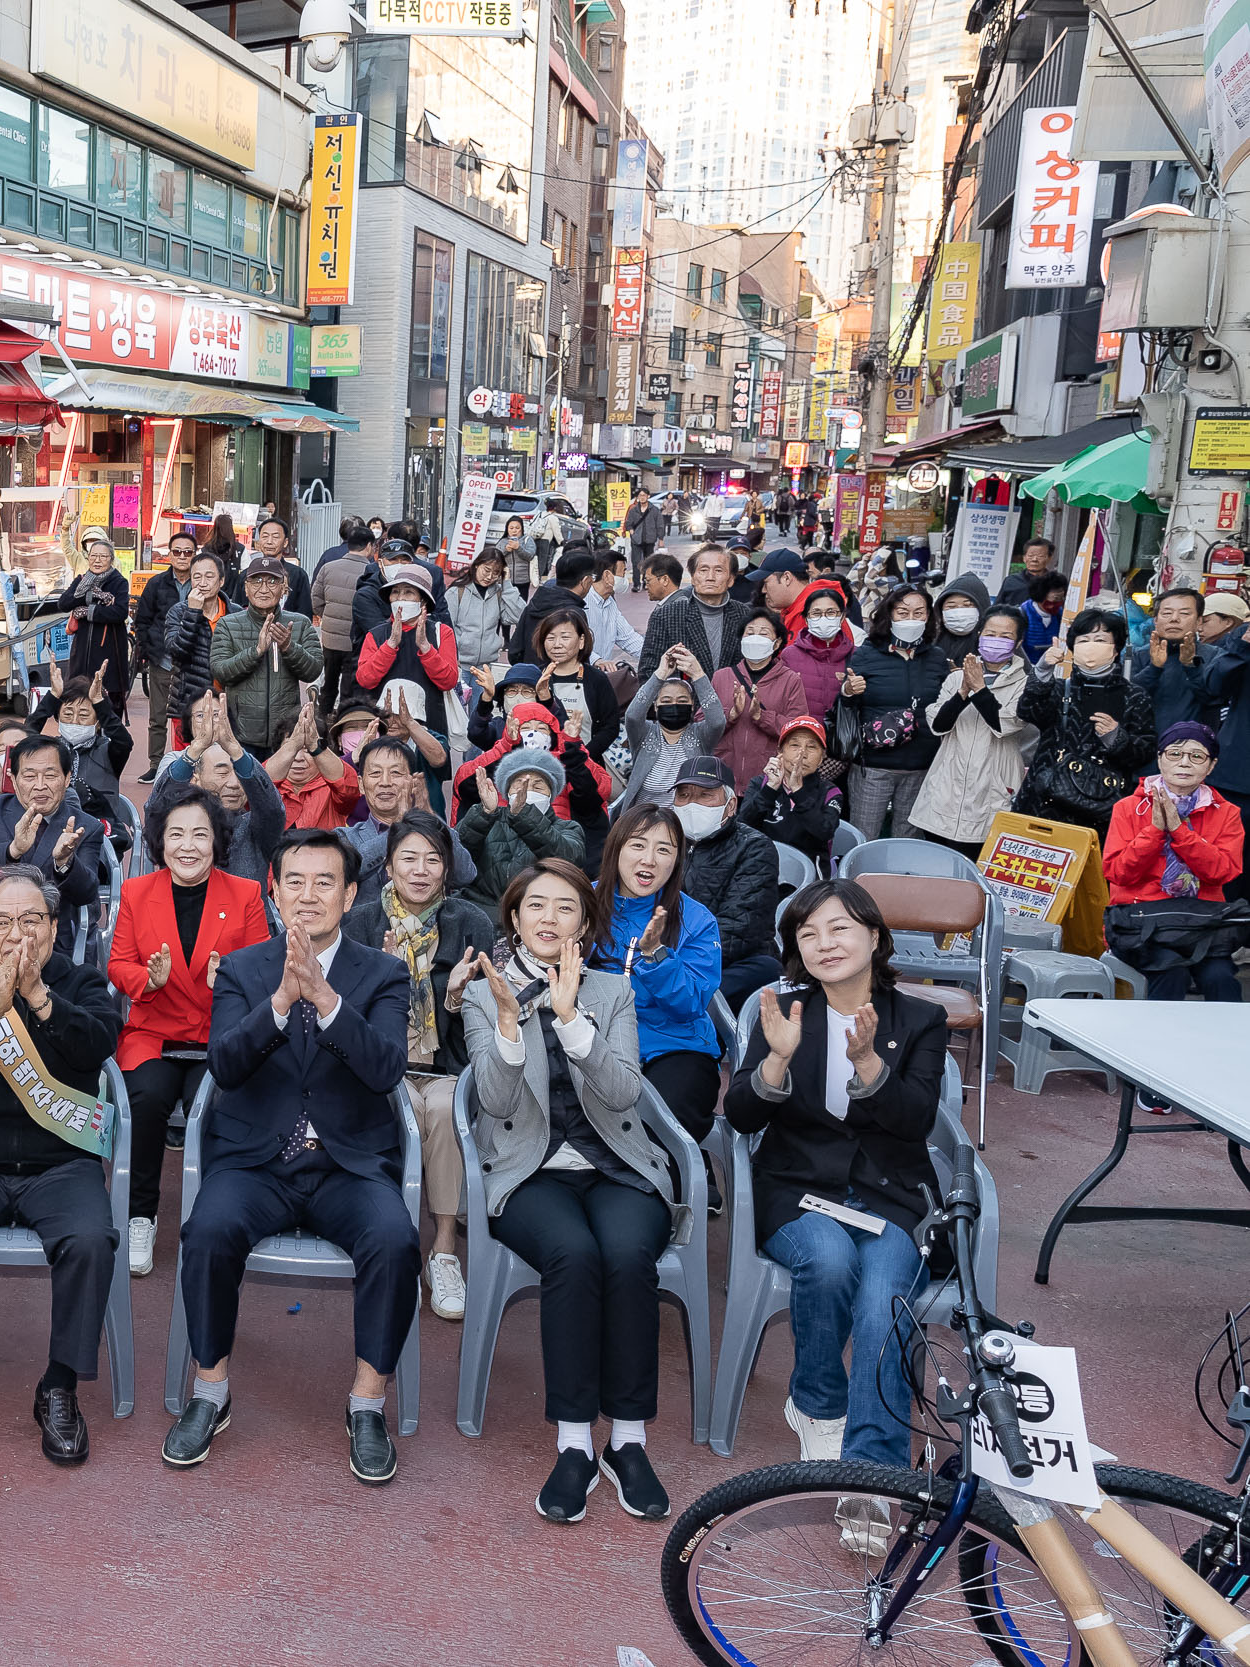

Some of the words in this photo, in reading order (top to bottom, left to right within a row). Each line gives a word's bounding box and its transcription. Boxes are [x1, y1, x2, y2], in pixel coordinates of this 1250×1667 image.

[423, 1, 467, 24] CCTV
[470, 2, 511, 26] 작동중
[1023, 264, 1048, 277] 맥주
[1051, 264, 1076, 276] 양주
[615, 265, 642, 330] 부동산
[937, 259, 969, 347] 中国食品
[188, 306, 242, 351] 상주축산
[317, 333, 350, 350] 365
[193, 351, 237, 377] T.464-7012
[317, 350, 334, 360] Auto
[334, 350, 354, 360] Bank
[614, 344, 633, 412] 금은보석시계
[473, 393, 488, 408] 약
[468, 479, 492, 491] OPEN
[911, 469, 938, 481] 커피
[609, 487, 628, 499] 황소
[82, 511, 107, 523] 7.600
[464, 509, 484, 521] 종로
[863, 483, 882, 544] 中国食品
[970, 513, 1006, 526] 삼성생명
[457, 521, 481, 561] 약국
[988, 853, 1063, 894] 주차금지
[679, 1526, 709, 1563] COMPASS
